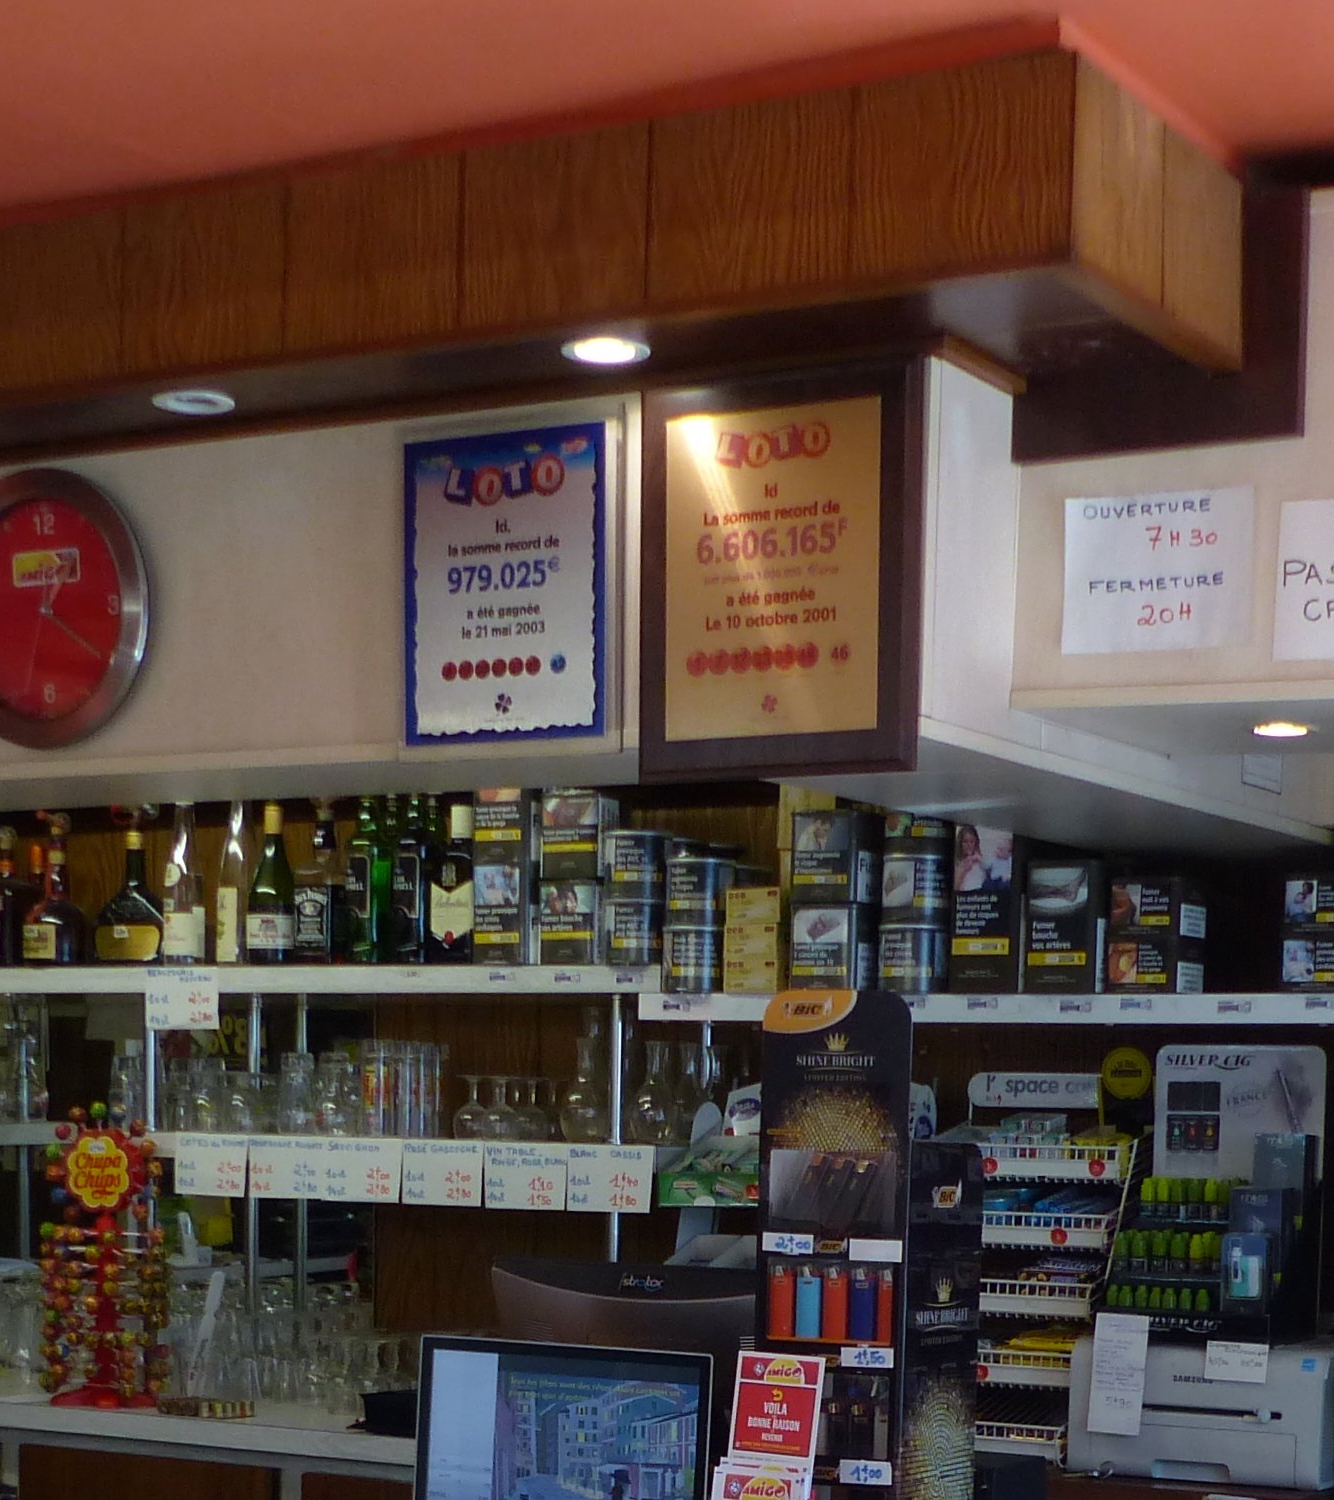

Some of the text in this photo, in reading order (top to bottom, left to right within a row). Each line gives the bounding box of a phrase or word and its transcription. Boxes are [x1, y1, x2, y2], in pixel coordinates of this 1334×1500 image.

[716, 421, 831, 468] LOTO
[444, 453, 565, 507] LOTO
[703, 500, 841, 527] La somme record de
[1083, 497, 1213, 521] OUVERTURE
[33, 512, 56, 535] 12
[461, 542, 502, 556] somme
[504, 535, 542, 552] record
[543, 534, 561, 549] de
[447, 556, 560, 595] 979.025€
[1088, 570, 1226, 595] FERMETURE
[107, 595, 120, 616] 3
[725, 586, 816, 607] a été gagnée
[466, 602, 541, 620] a été gagnée
[705, 606, 838, 632] Le 10 octobre 2001
[1137, 603, 1193, 628] 20H
[461, 619, 547, 640] le 21 mai 2003
[43, 683, 56, 704] 6
[793, 1003, 823, 1017] BIC
[796, 1054, 877, 1068] SHINE BRIGHT
[1166, 1053, 1253, 1070] SILVER CIG
[1005, 1076, 1059, 1098] space
[74, 1152, 122, 1173] Chupa
[74, 1170, 122, 1190] Chups
[937, 1188, 958, 1206] BIC
